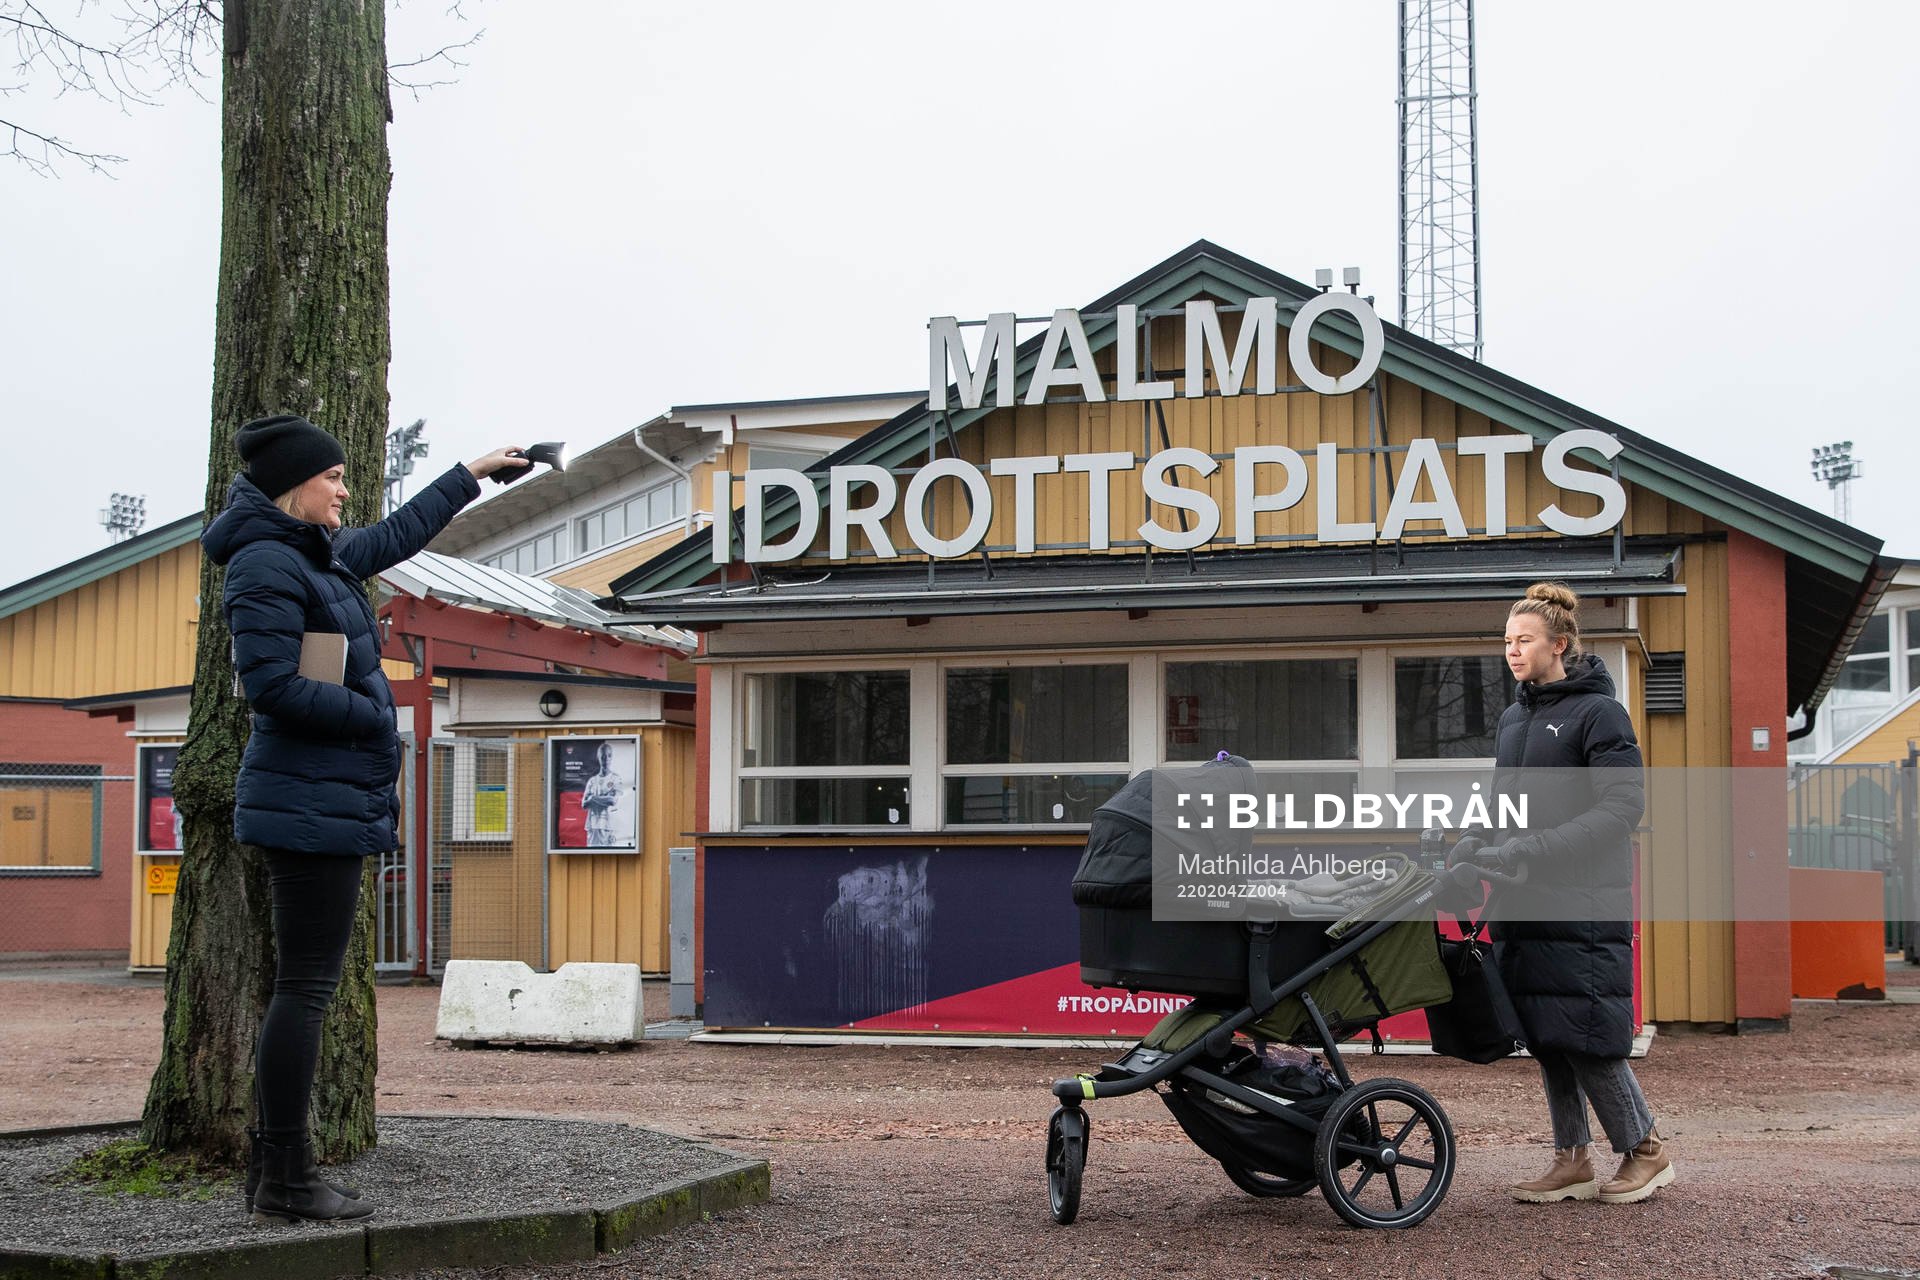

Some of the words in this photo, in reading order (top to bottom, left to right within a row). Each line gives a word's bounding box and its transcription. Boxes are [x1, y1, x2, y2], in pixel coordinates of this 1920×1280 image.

[928, 267, 1384, 411] MALMÖ
[711, 428, 1627, 565] IDROTTSPLATS
[1057, 992, 1196, 1014] #TROPÅDIND
